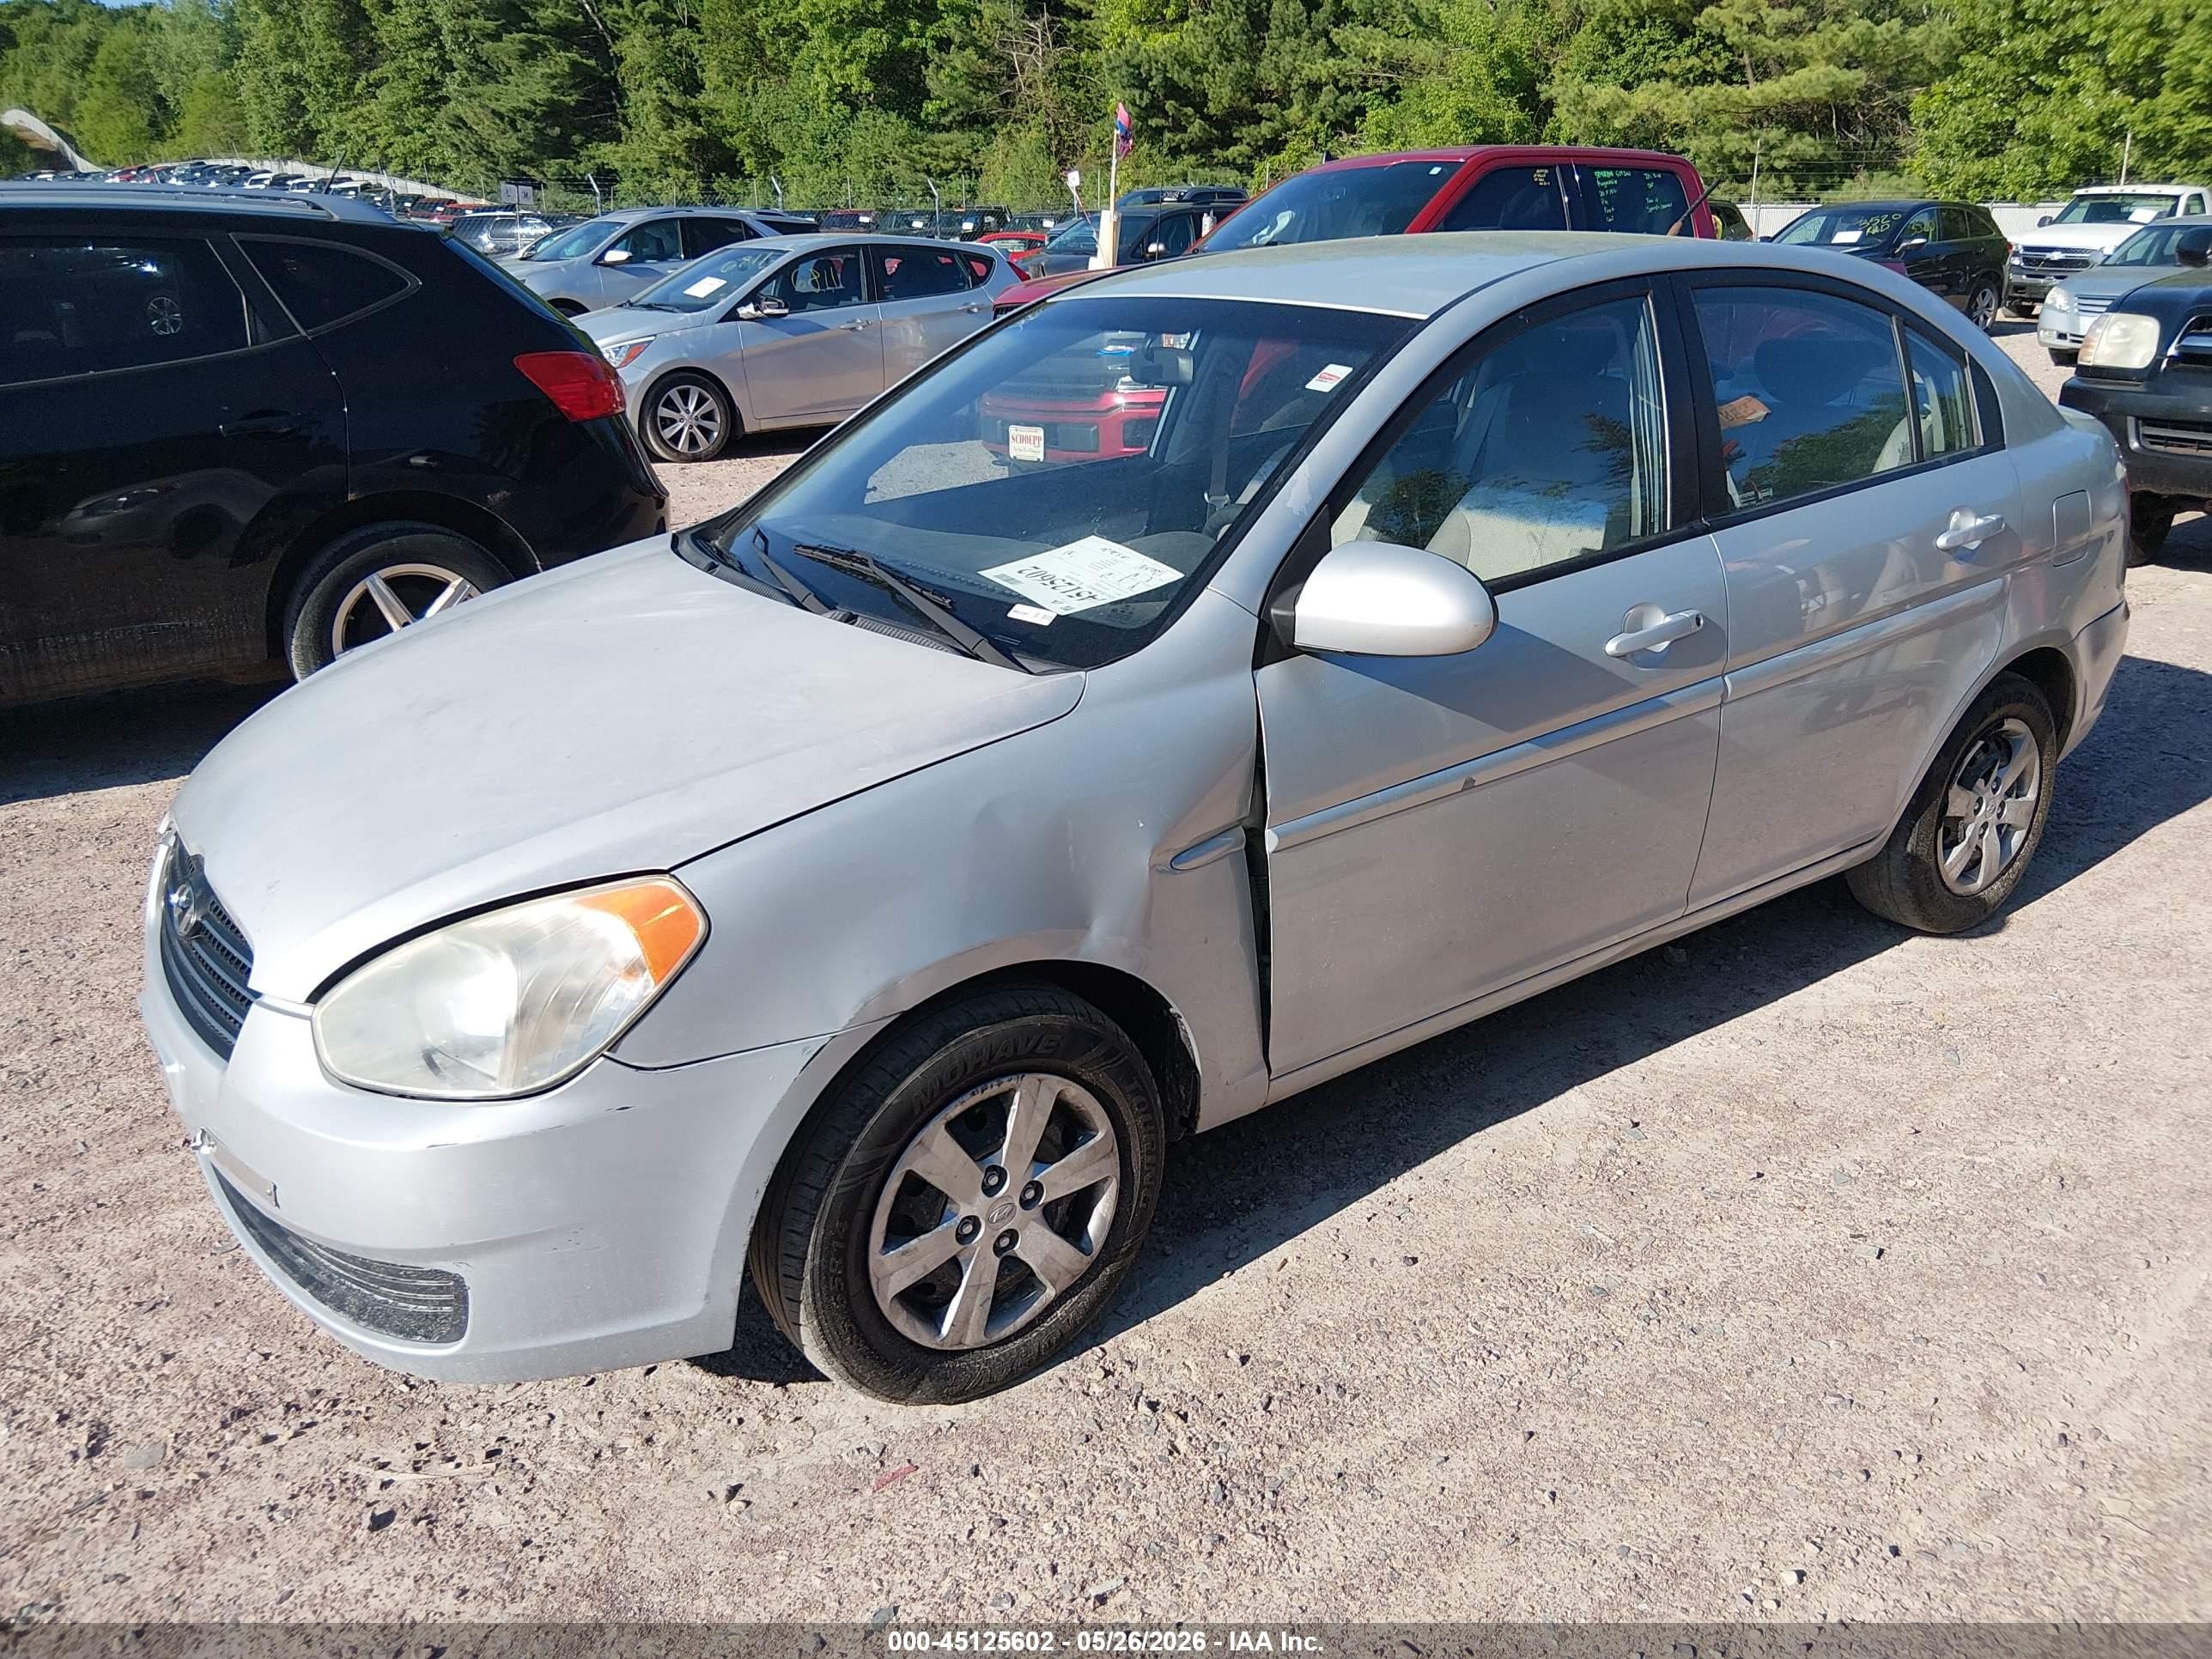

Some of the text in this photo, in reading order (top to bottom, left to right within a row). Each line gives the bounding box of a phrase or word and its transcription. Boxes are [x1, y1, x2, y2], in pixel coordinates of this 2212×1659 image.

[1855, 213, 1902, 231] 3520
[1011, 434, 1042, 447] SCHOEPP
[1018, 566, 1104, 603] 45125602
[912, 1032, 1066, 1114] MOHAVE
[1127, 1077, 1158, 1209] TOURING
